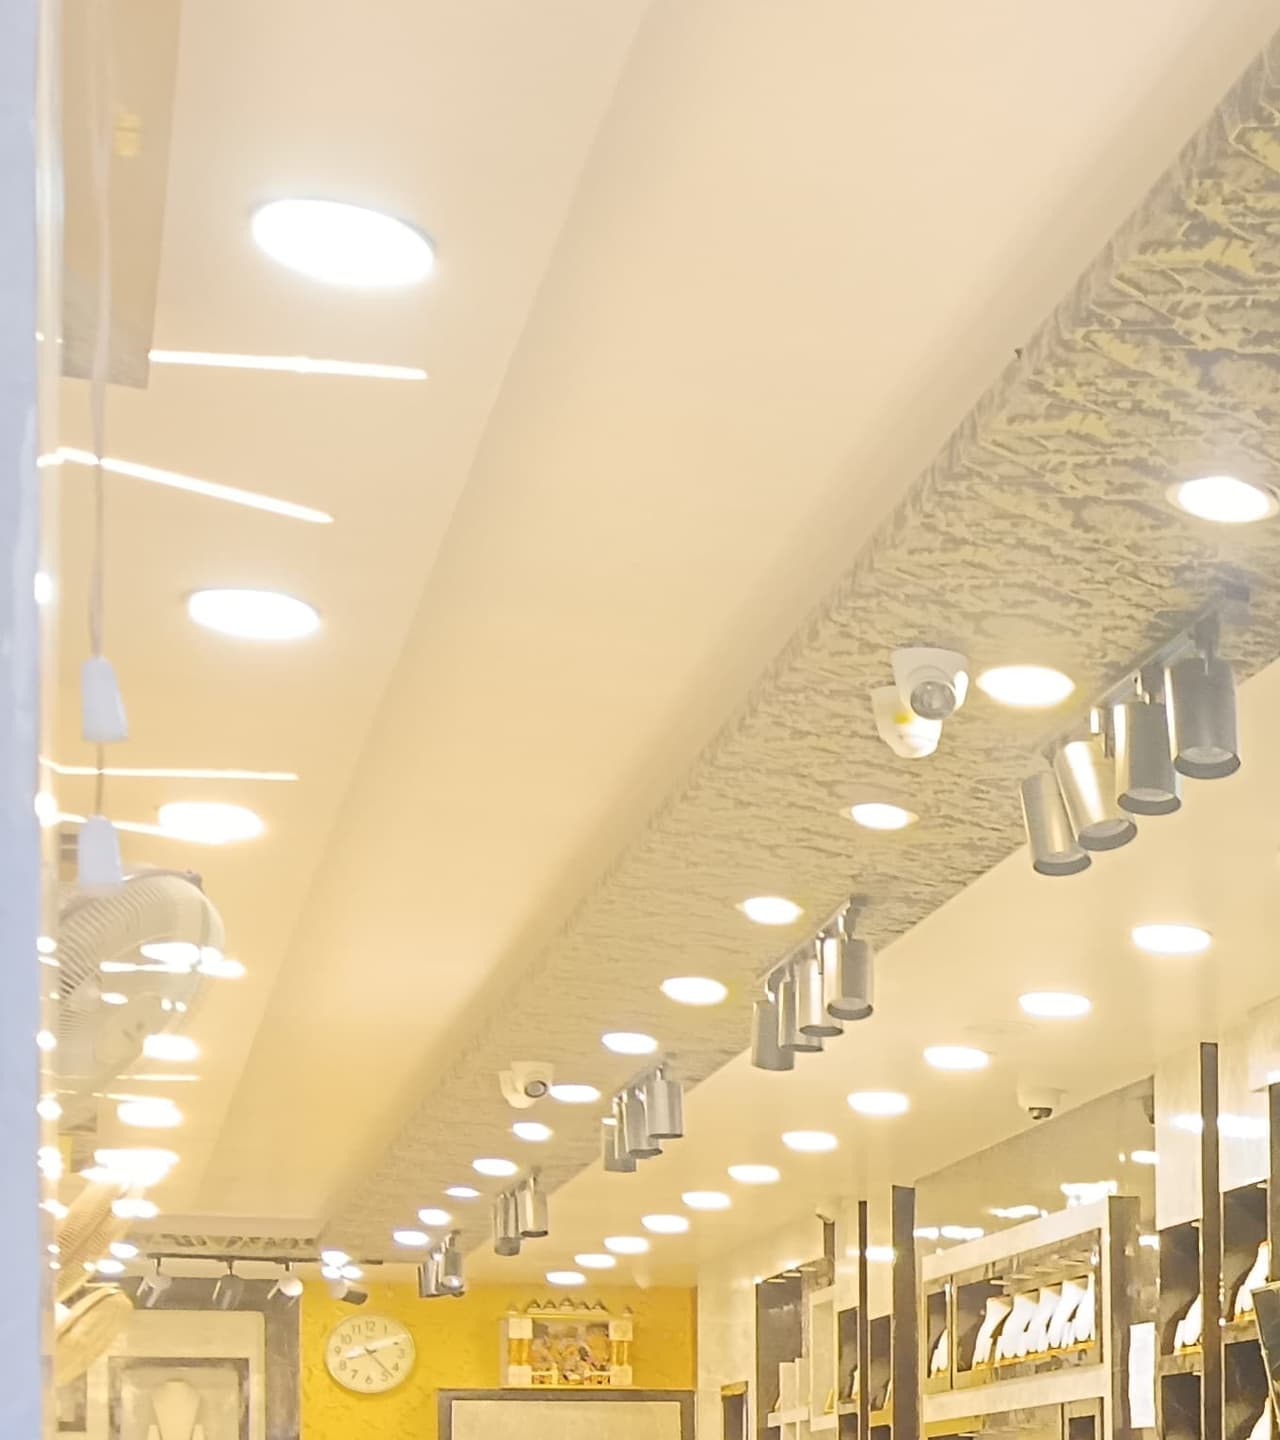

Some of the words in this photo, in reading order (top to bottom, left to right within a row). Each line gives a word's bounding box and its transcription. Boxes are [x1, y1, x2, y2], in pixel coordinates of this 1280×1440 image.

[352, 1324, 361, 1335] 11
[365, 1319, 376, 1332] 12
[340, 1333, 353, 1345] 10
[334, 1345, 342, 1355] 9
[350, 1368, 358, 1380] 7
[364, 1374, 373, 1385] 6
